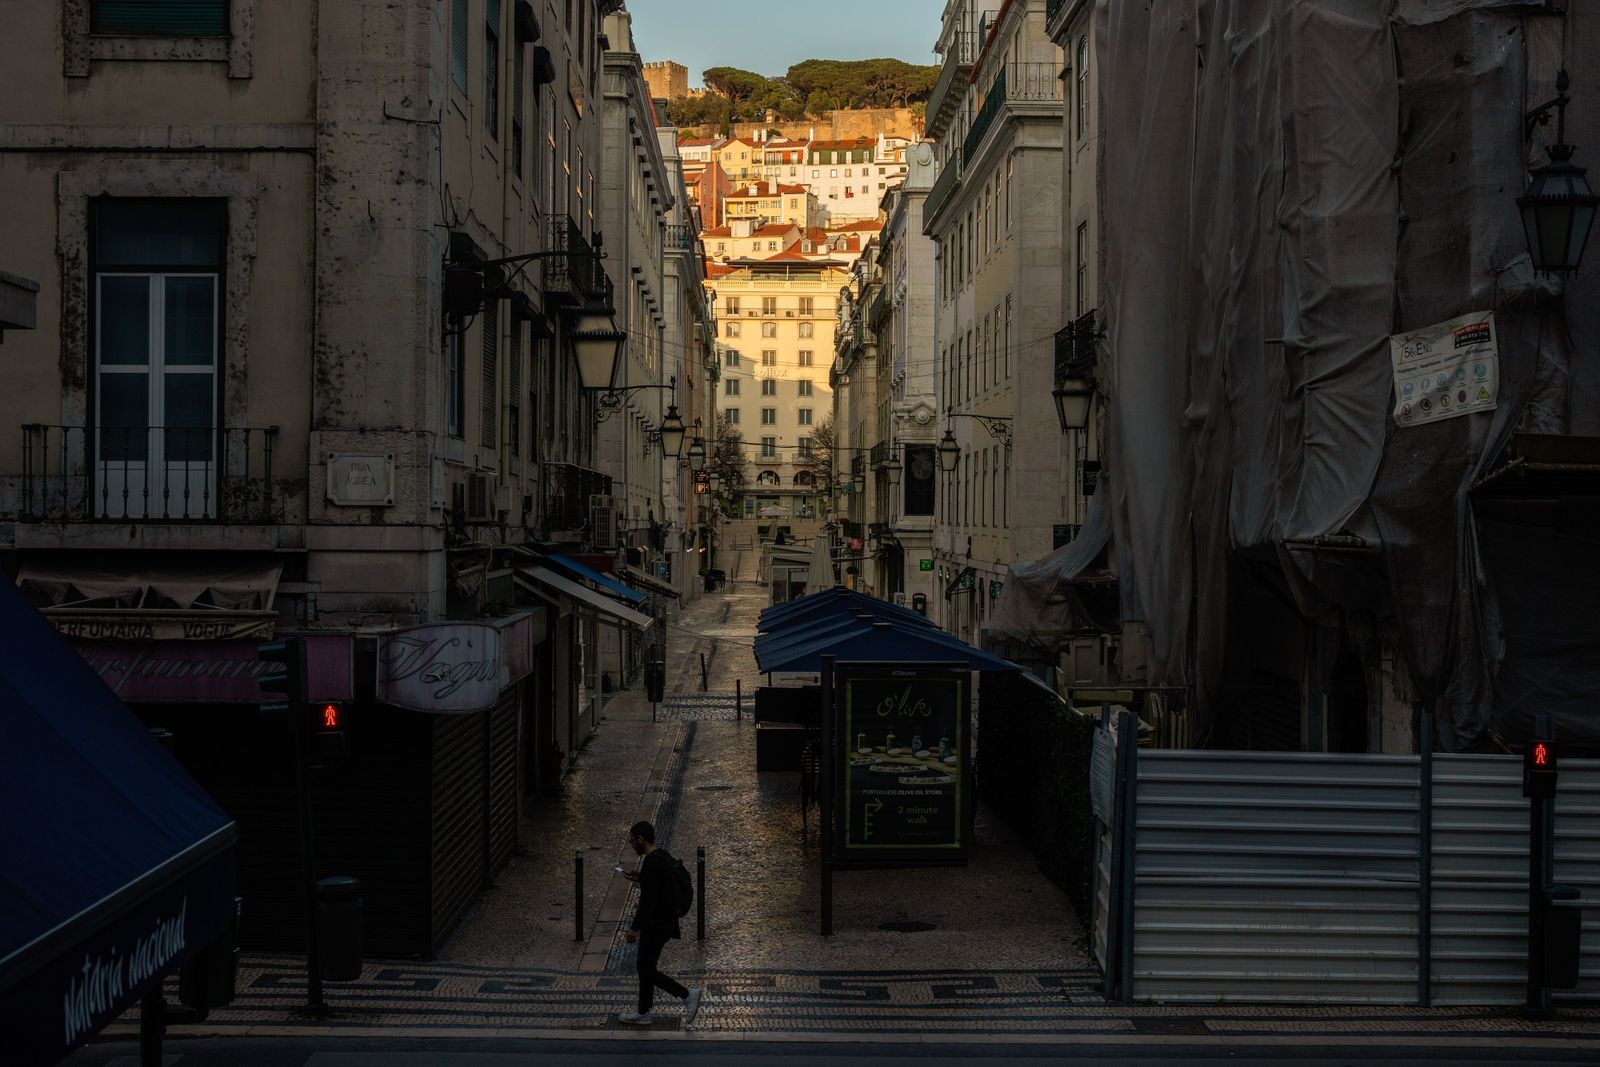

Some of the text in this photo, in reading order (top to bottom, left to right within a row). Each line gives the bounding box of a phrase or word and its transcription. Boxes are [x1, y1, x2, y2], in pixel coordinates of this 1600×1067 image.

[351, 463, 371, 472] RUA
[57, 622, 153, 640] ERFUMARIA
[379, 635, 499, 699] Vogu
[897, 804, 939, 815] 2 minute
[905, 815, 929, 825] walk
